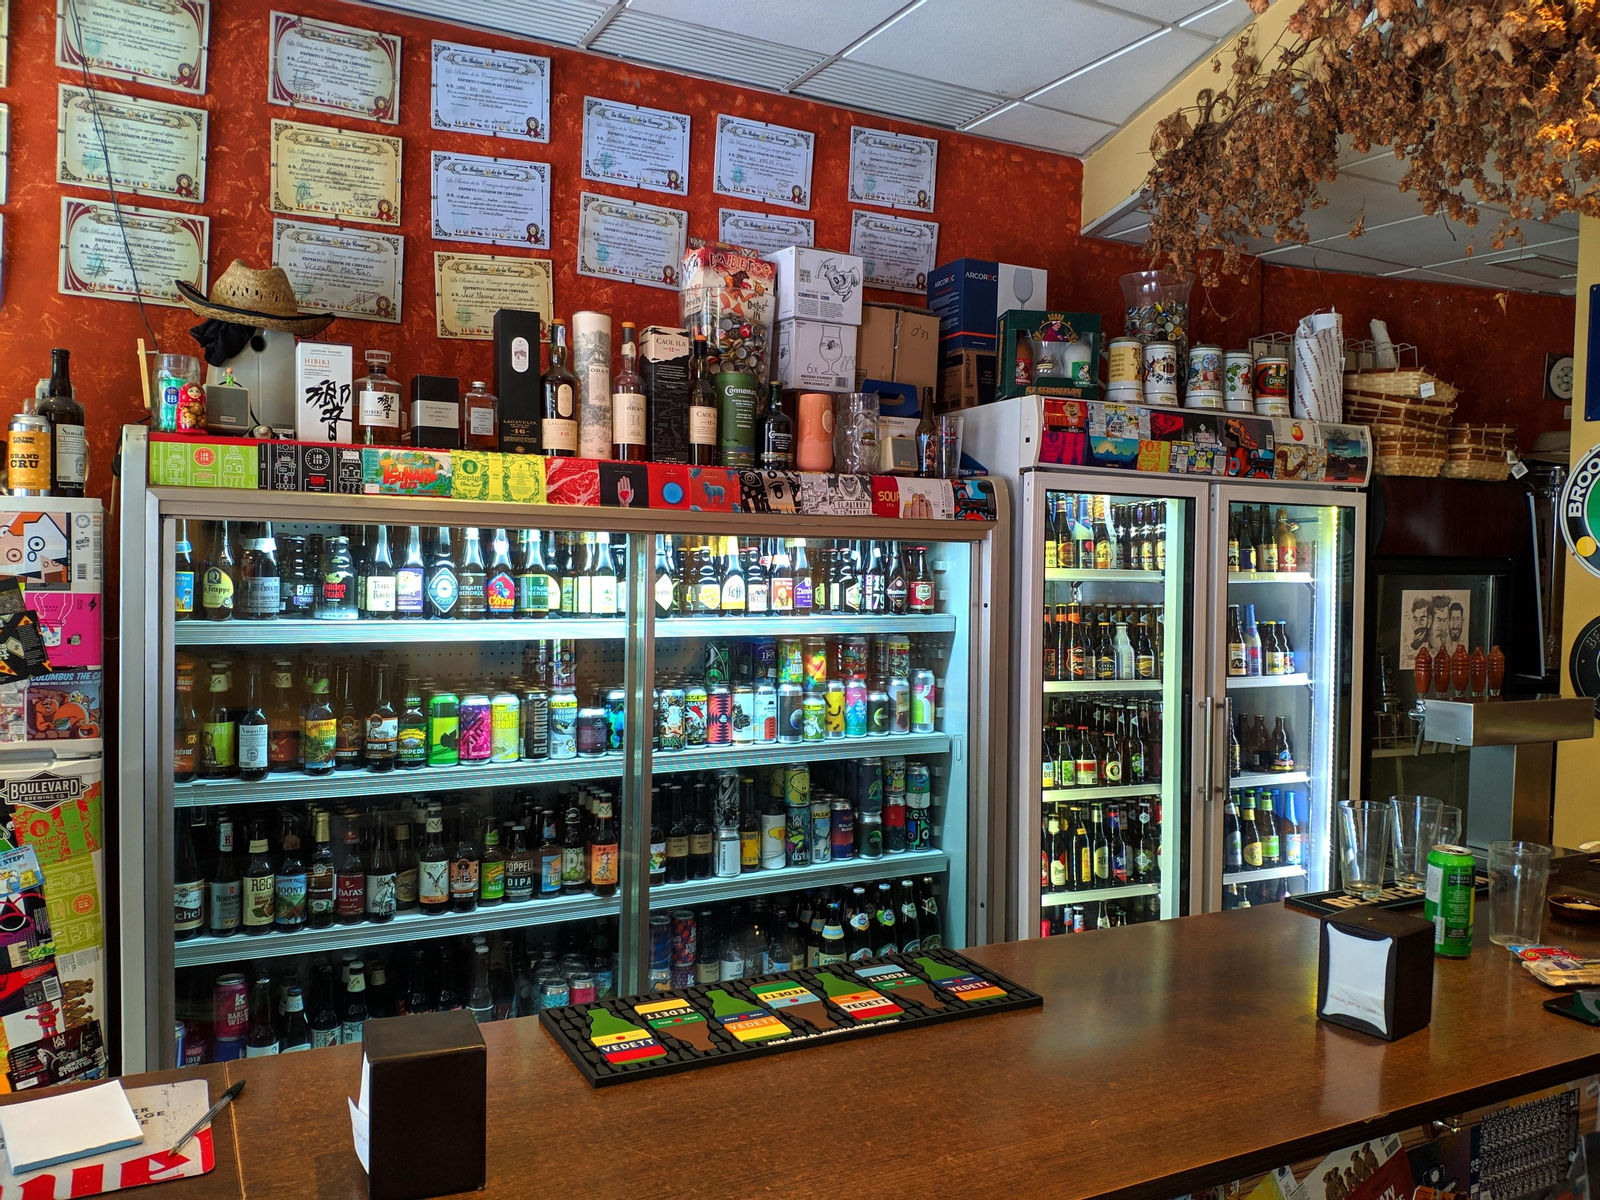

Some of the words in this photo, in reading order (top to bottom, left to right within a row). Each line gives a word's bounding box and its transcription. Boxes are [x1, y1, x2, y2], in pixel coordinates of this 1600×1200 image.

[314, 235, 331, 243] Botica
[352, 240, 371, 251] Cerveza
[709, 253, 746, 268] DOUBLE
[749, 258, 773, 275] DOG
[933, 274, 955, 288] ARCOROC
[964, 271, 997, 282] ARCOROC
[655, 337, 676, 346] CAOL
[167, 394, 177, 403] HB
[10, 460, 39, 468] CRU
[310, 476, 325, 484] BOB
[76, 672, 91, 680] THE
[533, 699, 548, 755] GLORIOUS
[10, 780, 78, 800] BOULEVARD
[505, 861, 533, 872] POPPELS
[507, 878, 532, 886] DIPA
[868, 971, 911, 983] VEDETT
[948, 981, 991, 993] VEDETT
[760, 988, 808, 1000] VEDETT
[847, 998, 889, 1010] VEDETT
[645, 1007, 695, 1020] VEDETT
[729, 1017, 777, 1031] VEDETT
[601, 1038, 655, 1053] VEDETT
